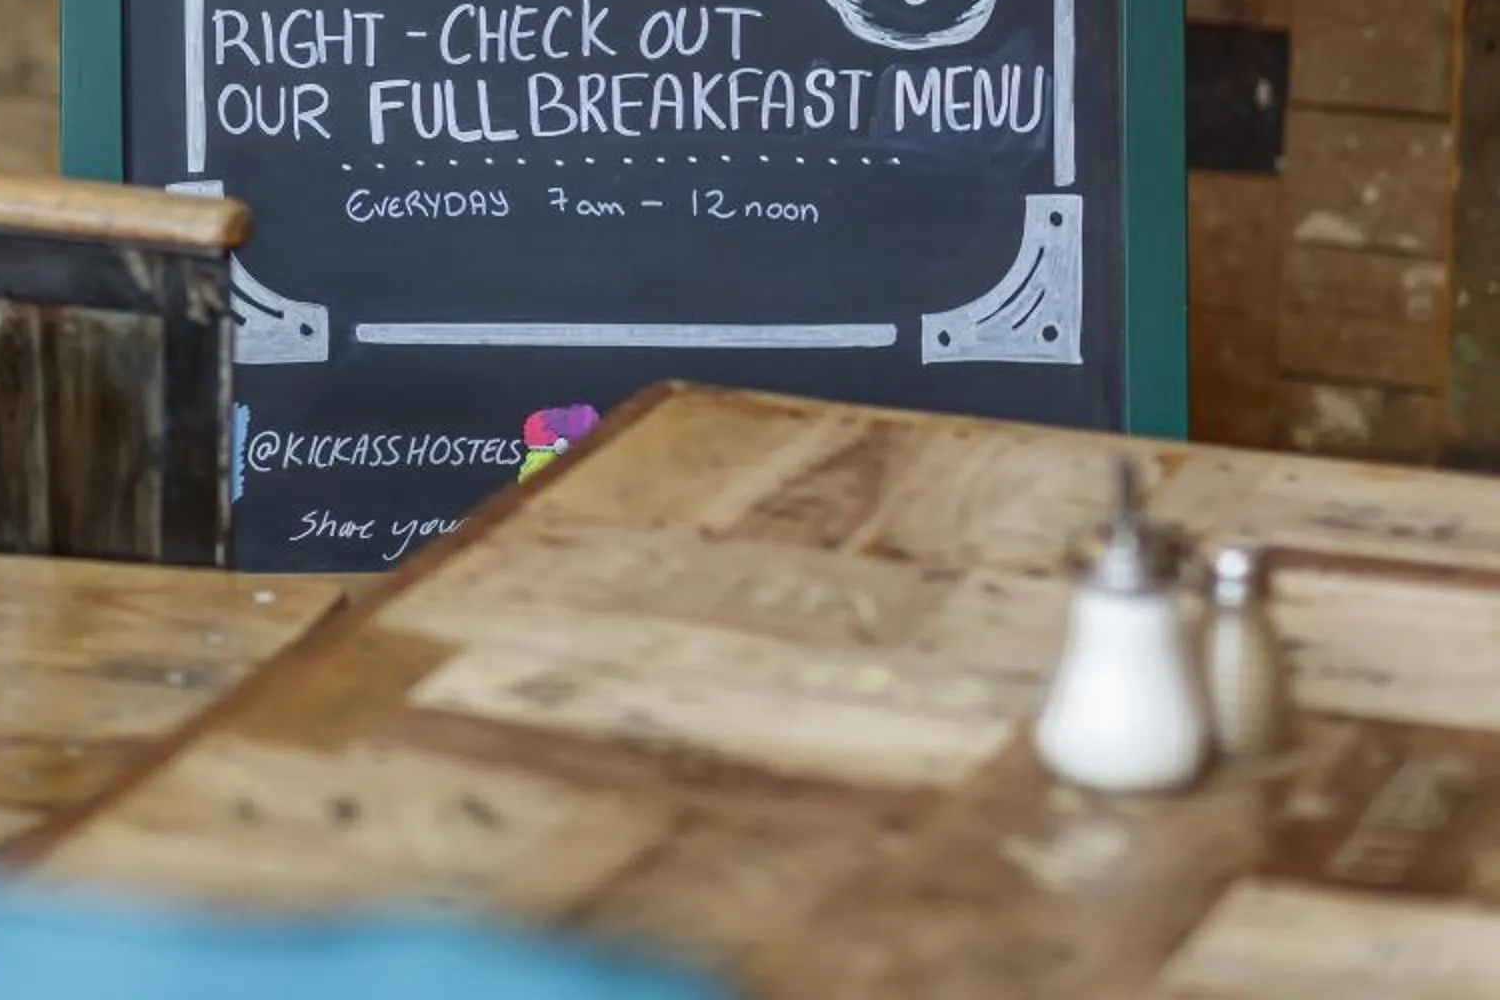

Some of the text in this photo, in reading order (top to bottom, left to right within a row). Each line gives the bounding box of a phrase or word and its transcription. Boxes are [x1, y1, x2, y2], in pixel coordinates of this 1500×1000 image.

[212, 8, 385, 69] RIGHT
[639, 7, 763, 60] OUT
[217, 63, 1045, 145] OUR FULL BREAKFAST MENU
